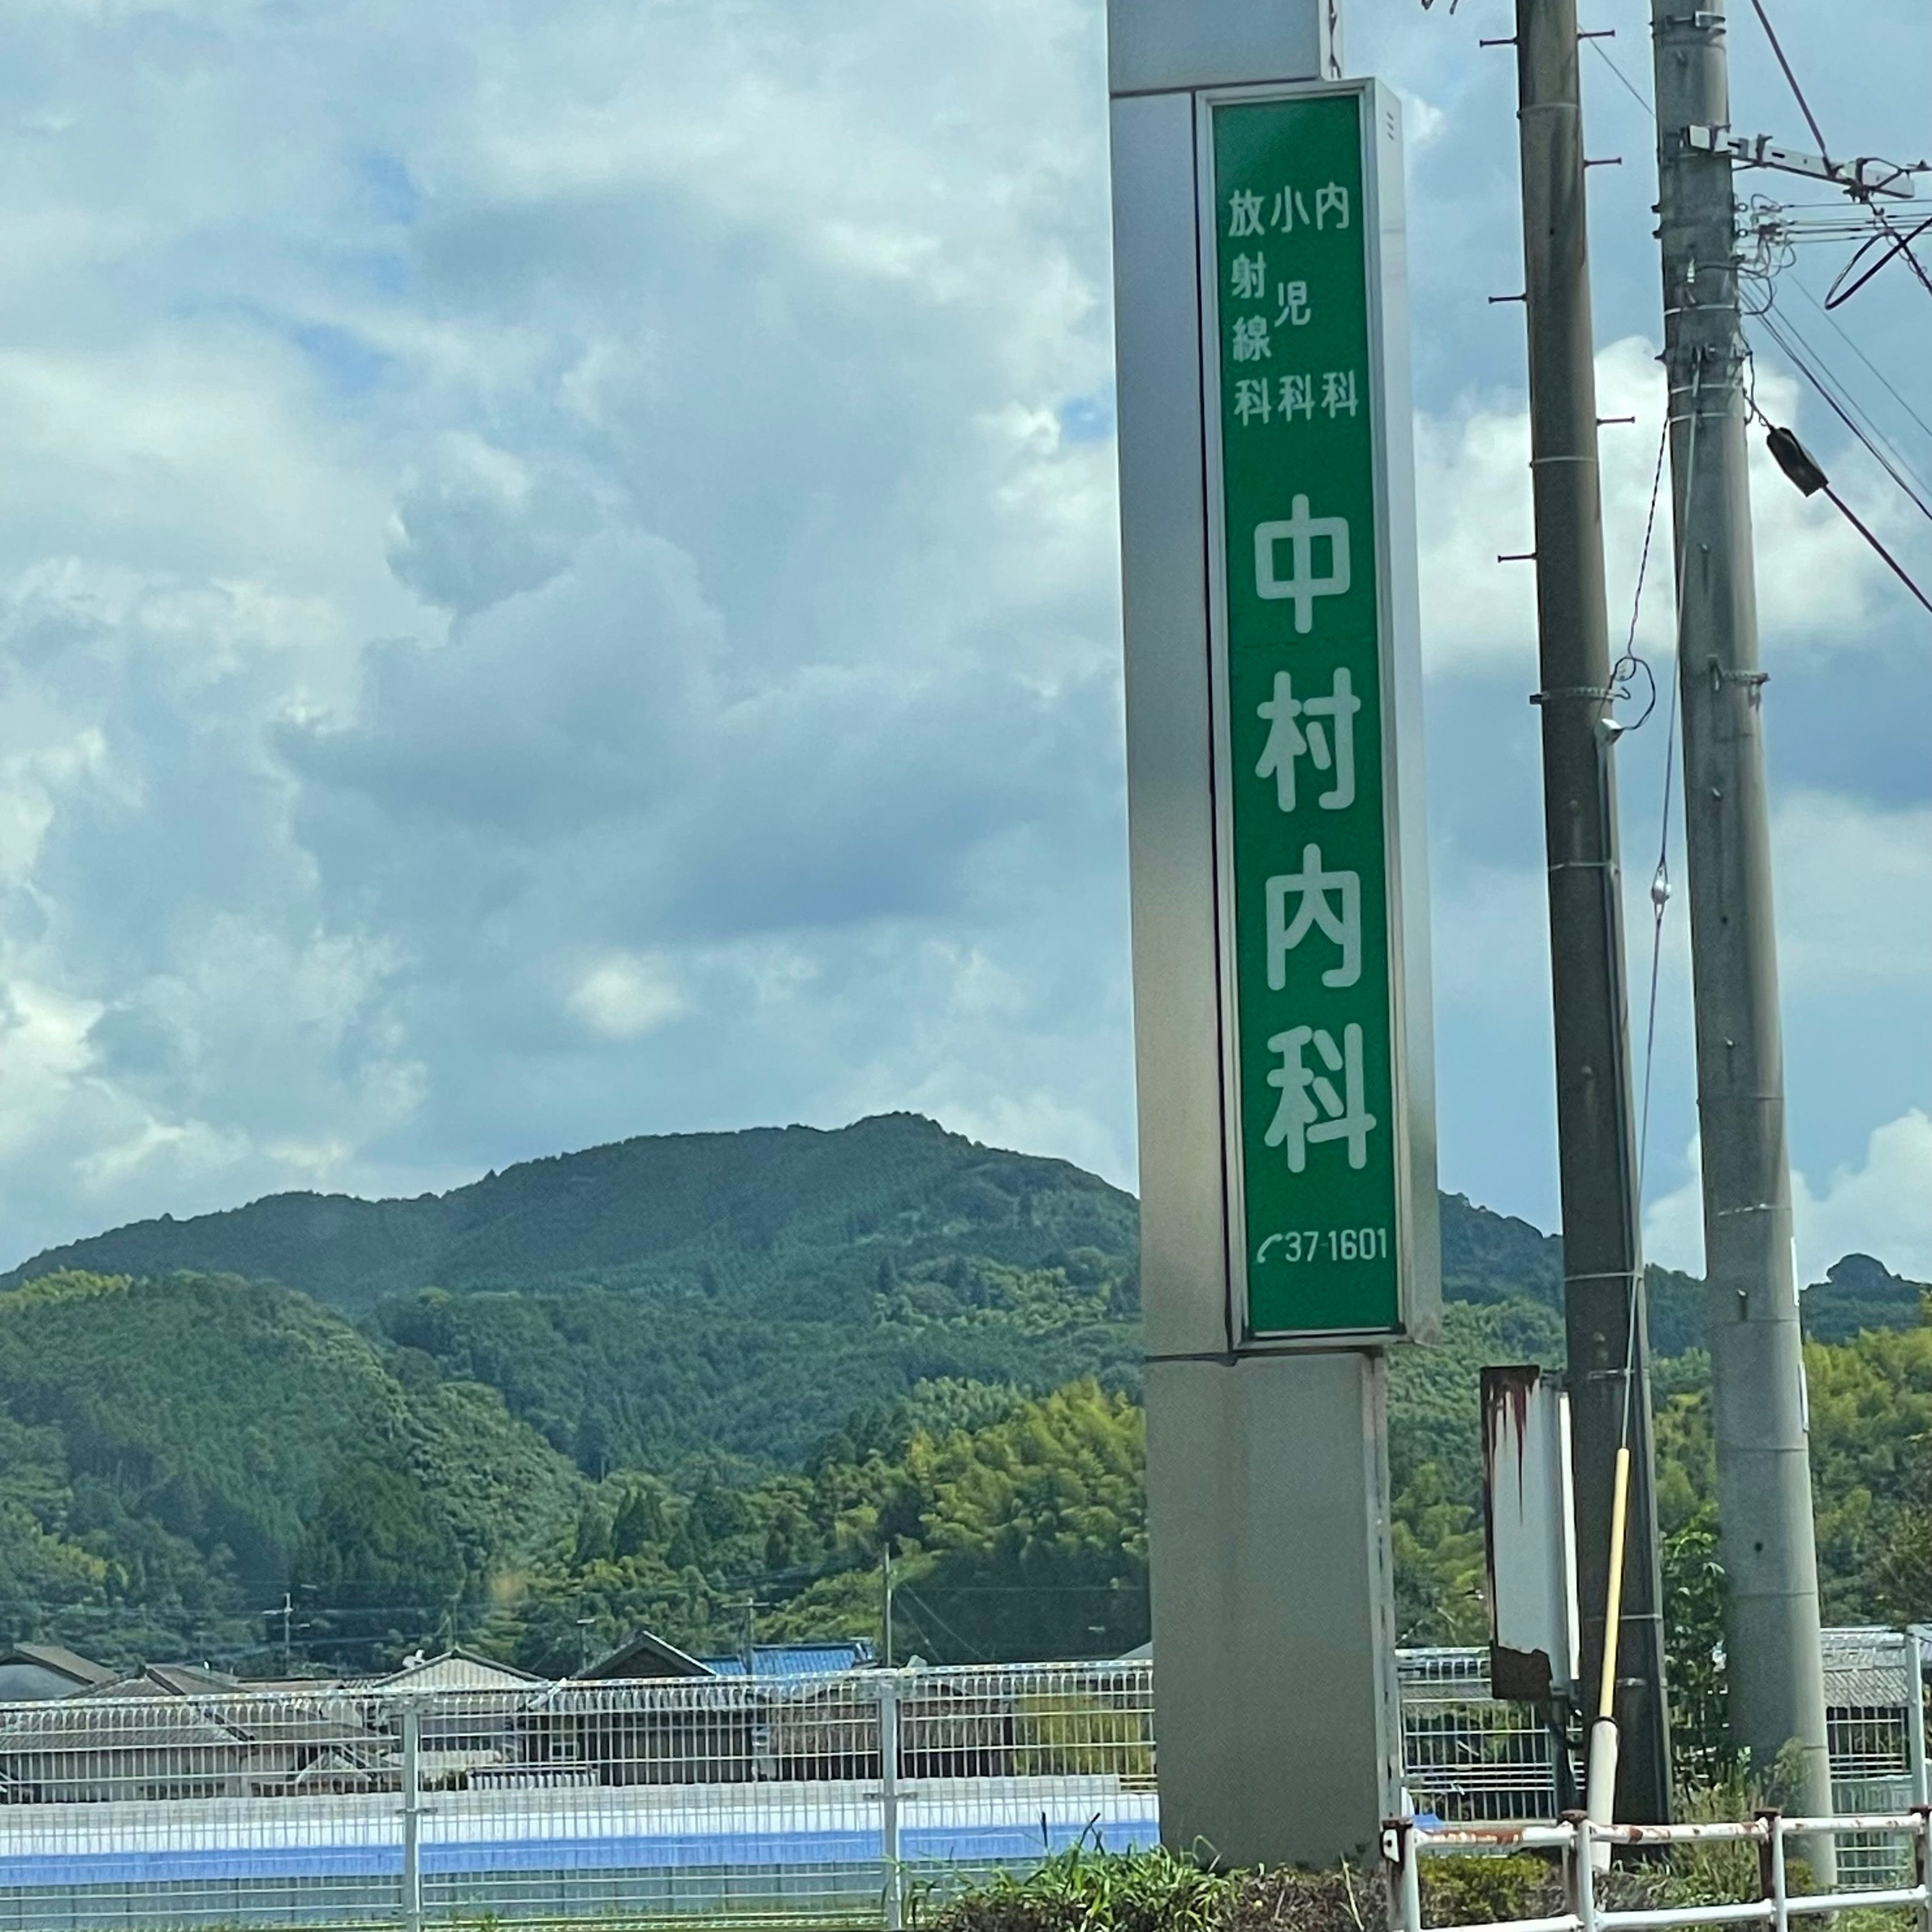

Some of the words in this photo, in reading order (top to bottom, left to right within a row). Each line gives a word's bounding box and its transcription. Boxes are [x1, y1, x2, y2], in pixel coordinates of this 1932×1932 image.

[1229, 189, 1272, 426] 放射線科
[1271, 185, 1315, 422] 小児科
[1315, 181, 1359, 418] 内科
[1254, 493, 1377, 1173] 中村内科
[1285, 1227, 1386, 1262] 37-1601
